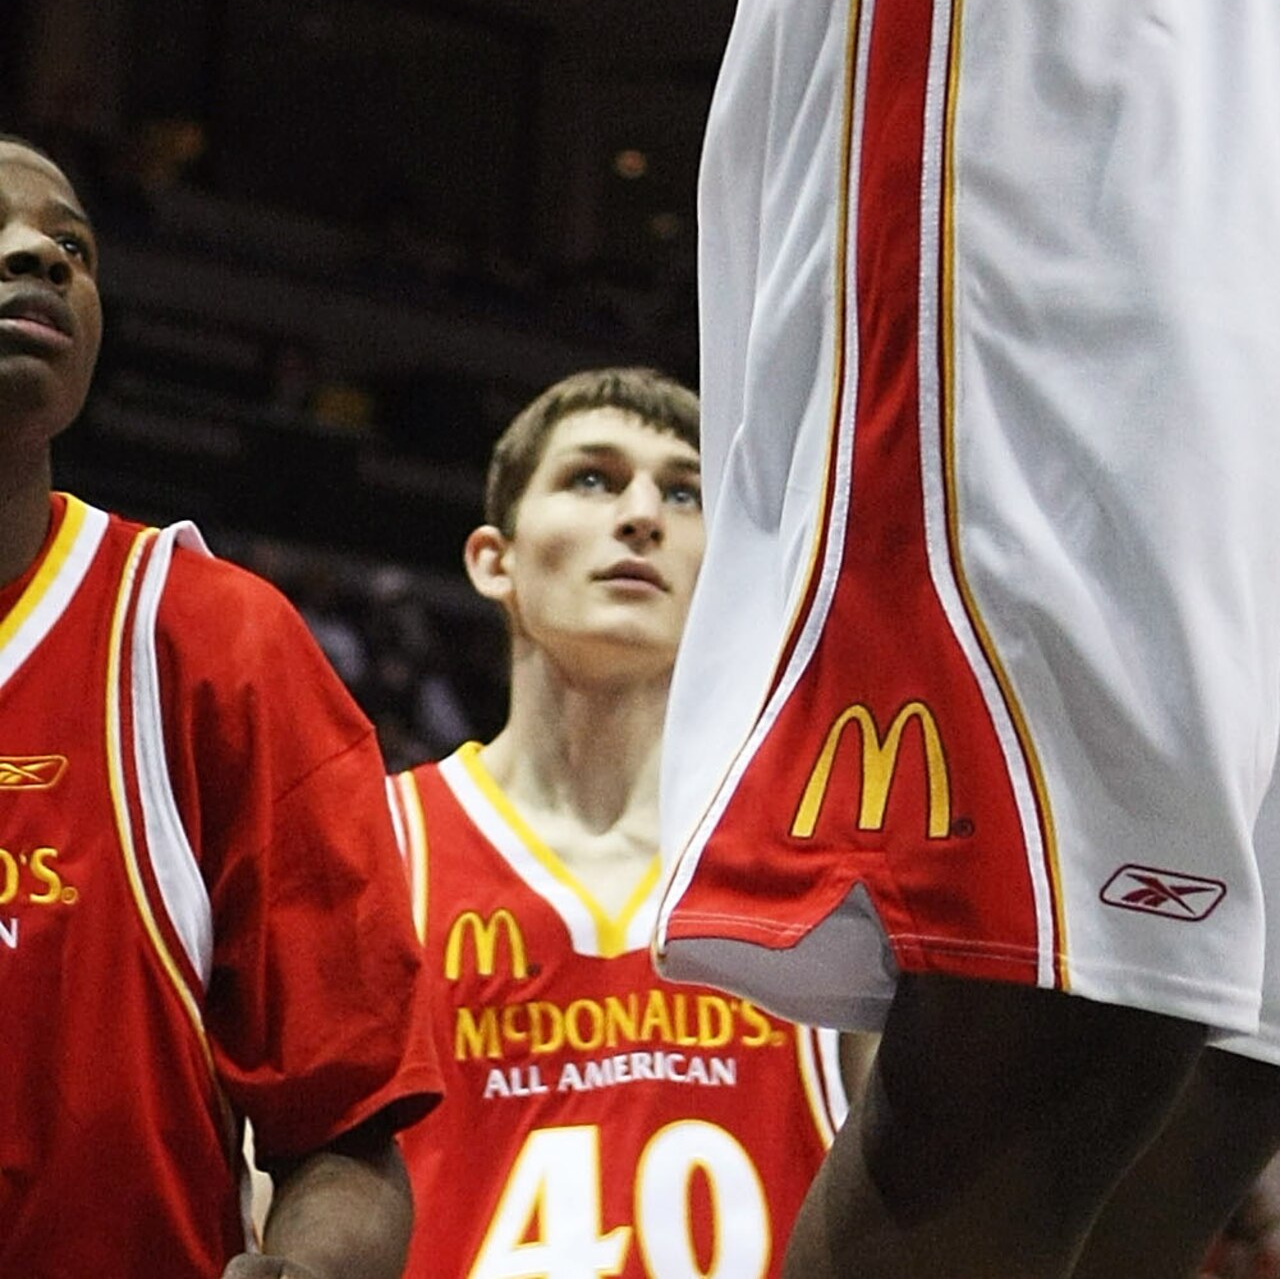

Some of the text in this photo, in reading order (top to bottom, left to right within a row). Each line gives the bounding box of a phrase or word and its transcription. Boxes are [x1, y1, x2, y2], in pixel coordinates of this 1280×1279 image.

[483, 1050, 738, 1099] ALL AMERICAN
[464, 1117, 772, 1279] 40
